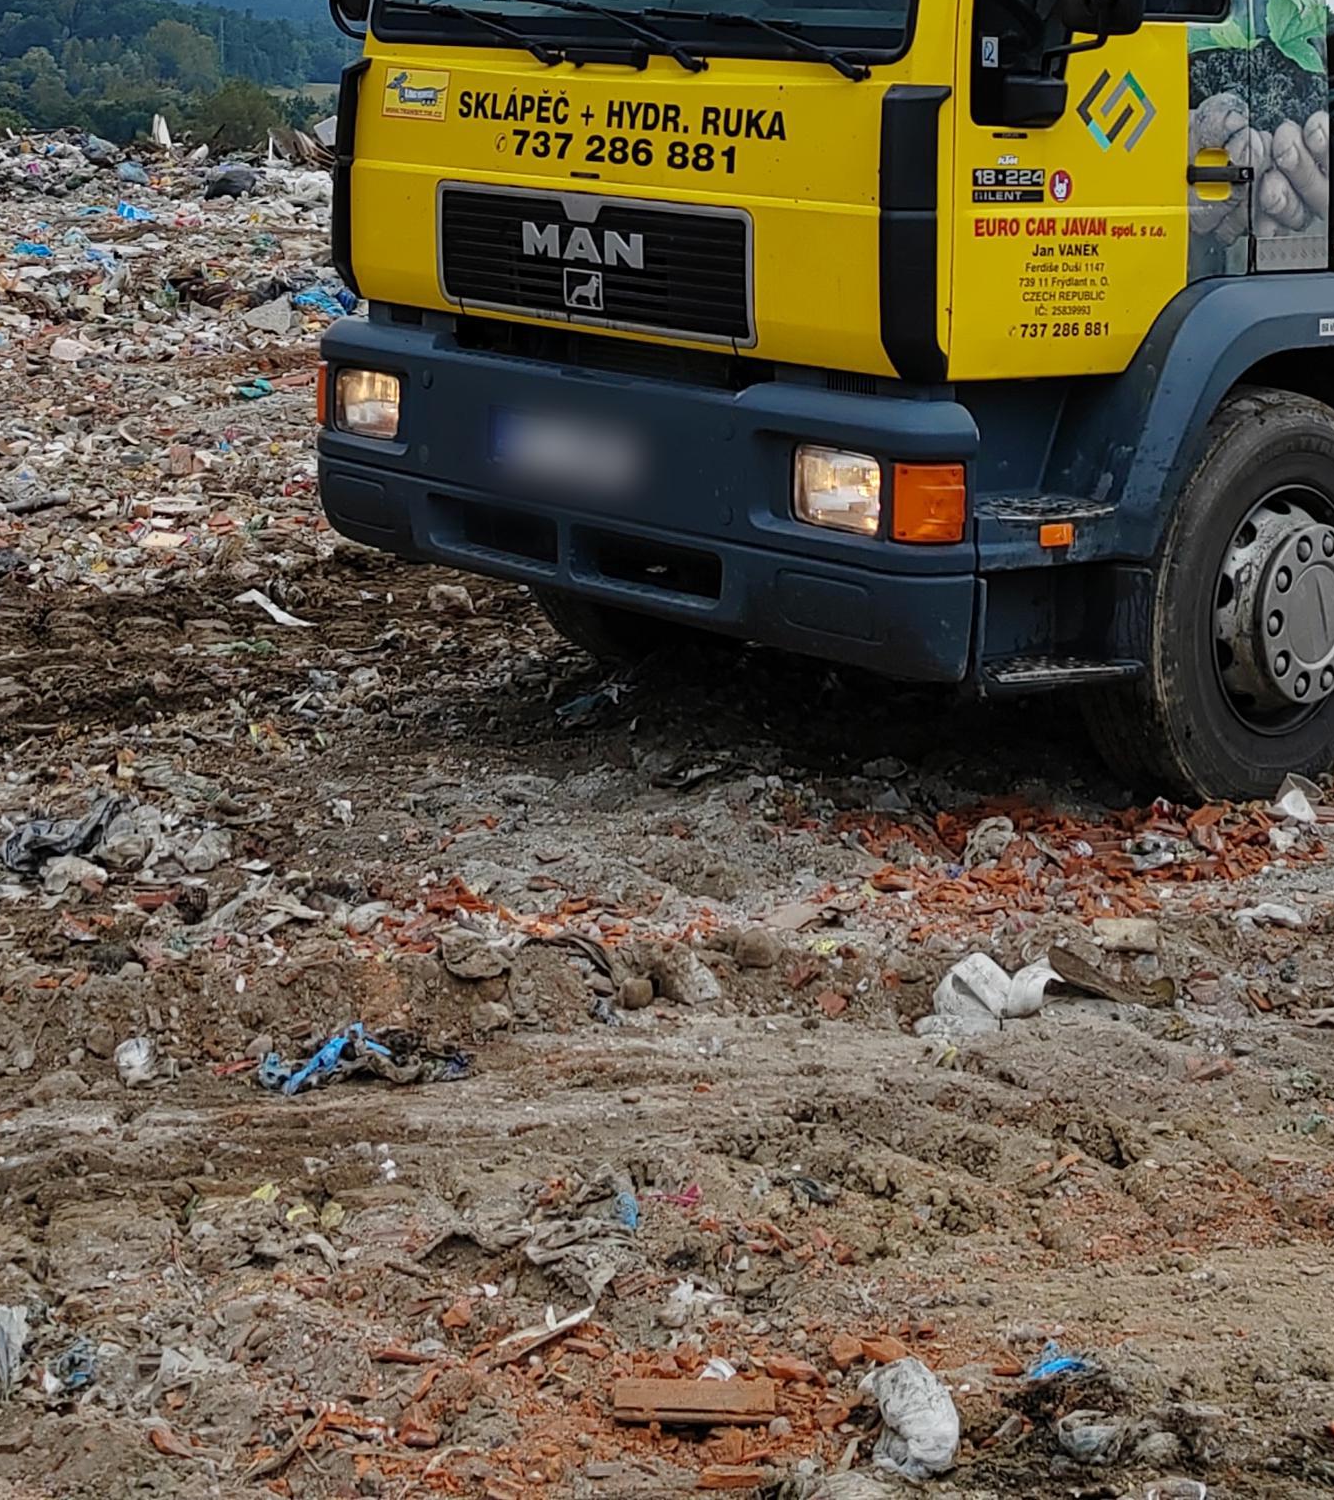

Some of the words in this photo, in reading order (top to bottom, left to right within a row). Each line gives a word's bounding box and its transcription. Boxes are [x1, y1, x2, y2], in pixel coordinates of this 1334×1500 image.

[458, 87, 569, 125] SKLÁPĚČ
[580, 104, 595, 126] +
[606, 100, 689, 134] HYDR.
[701, 106, 787, 141] RUKA
[512, 129, 573, 160] 737
[585, 134, 654, 167] 286
[666, 141, 736, 174] 881
[974, 217, 1021, 237] EURO
[1025, 217, 1056, 236] CAR
[1061, 217, 1107, 236] JAVAN
[1111, 222, 1137, 239] spol.
[1140, 225, 1147, 237] s
[522, 221, 644, 269] MAN
[1032, 244, 1055, 257] Jan
[1085, 262, 1105, 272] 1147
[1022, 291, 1056, 302] CZECH
[1058, 290, 1106, 301] REPUBLIC
[1020, 323, 1048, 338] 737
[1052, 322, 1079, 337] 286
[1084, 321, 1110, 336] 881
